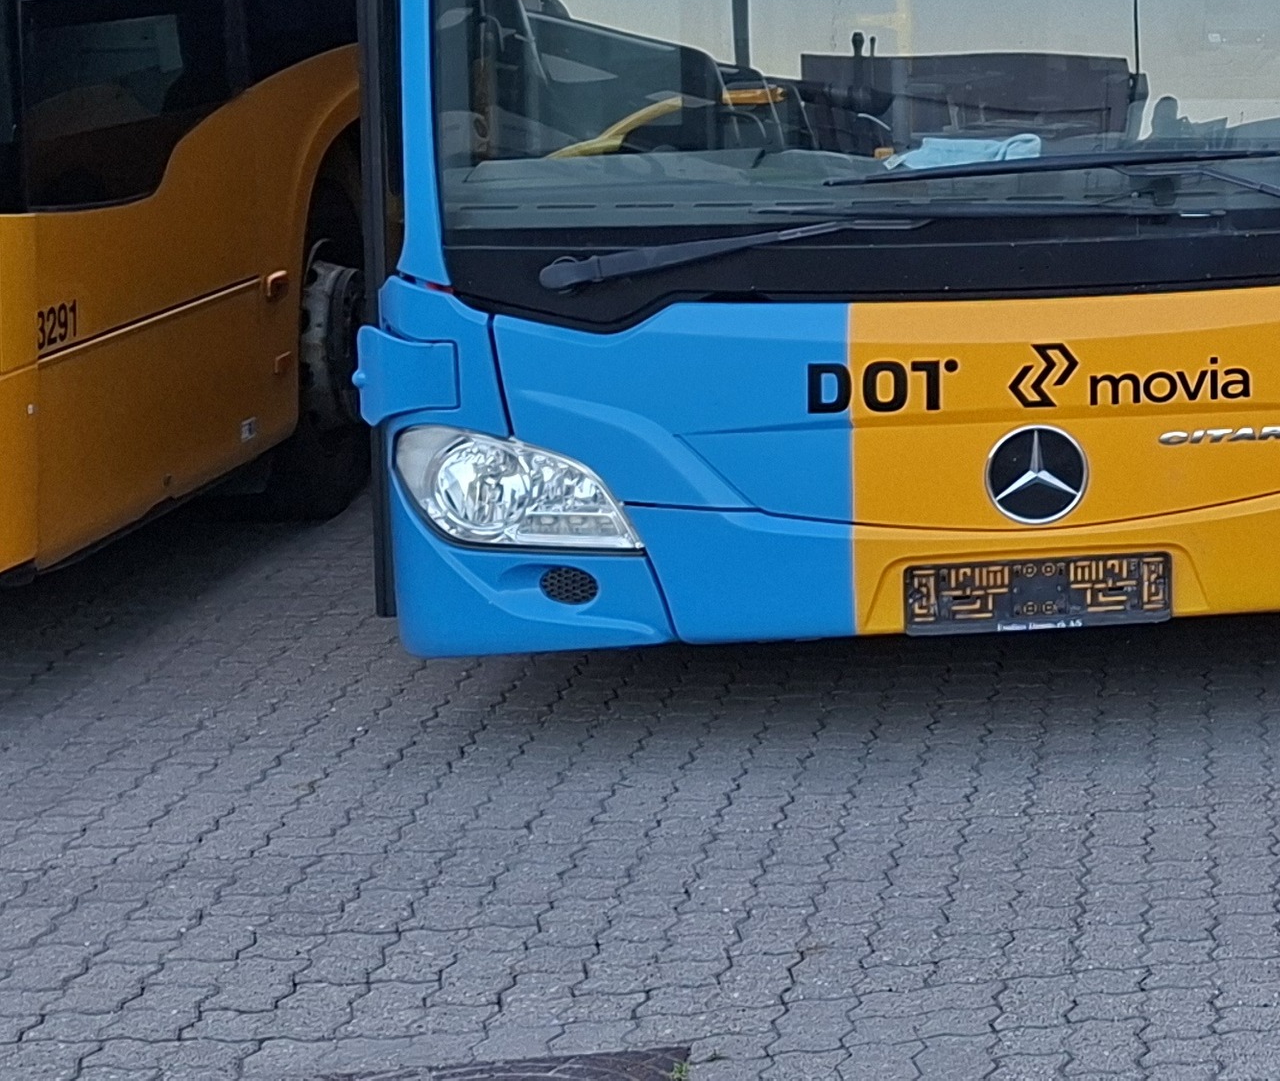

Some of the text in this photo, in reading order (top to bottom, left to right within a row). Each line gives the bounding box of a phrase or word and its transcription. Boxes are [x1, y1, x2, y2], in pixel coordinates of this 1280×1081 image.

[37, 299, 77, 350] 3291
[807, 358, 959, 415] DOT
[1089, 357, 1252, 406] movia
